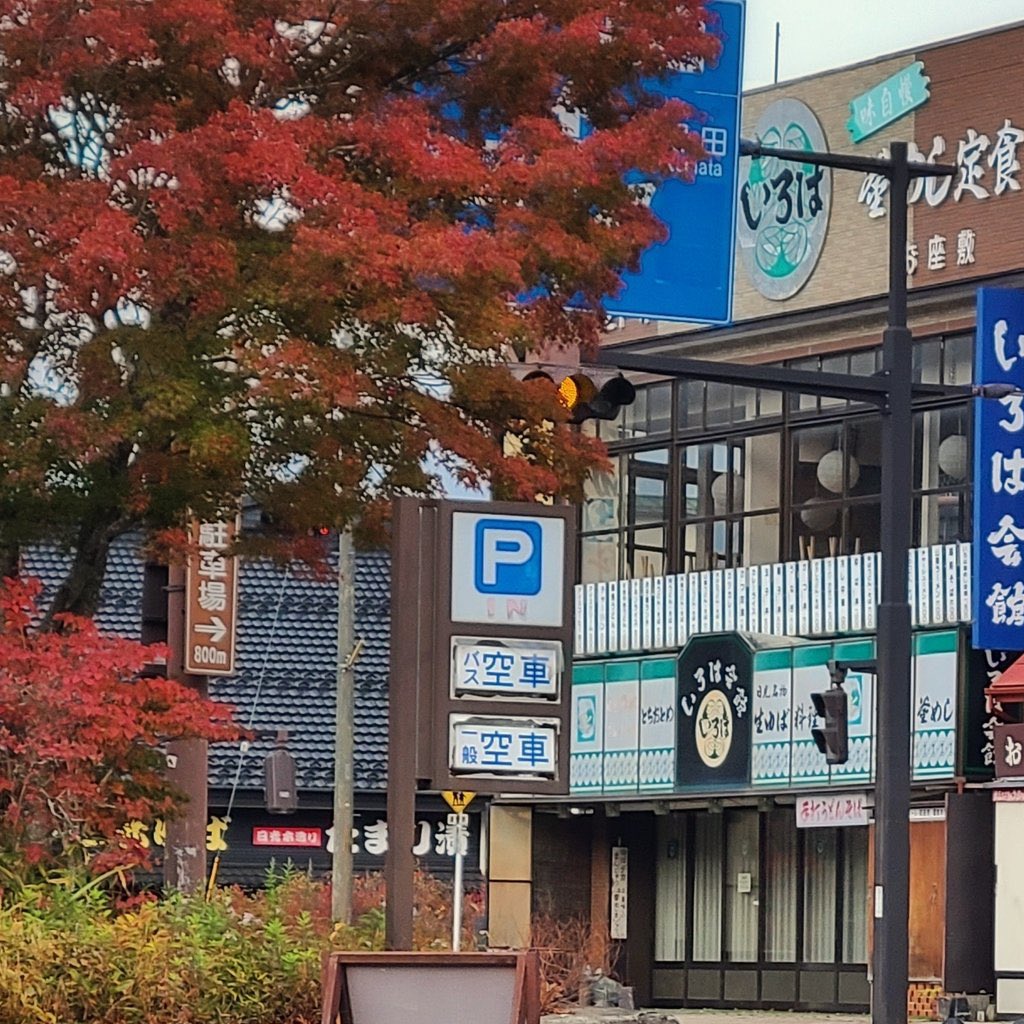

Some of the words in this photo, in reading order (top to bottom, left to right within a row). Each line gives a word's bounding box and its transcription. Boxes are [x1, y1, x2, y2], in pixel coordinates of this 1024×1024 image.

[740, 164, 825, 231] いろは
[482, 527, 534, 586] P
[193, 644, 227, 665] 800m
[482, 651, 551, 689] 空車
[917, 696, 953, 724] 釜めし
[480, 731, 550, 767] 空車
